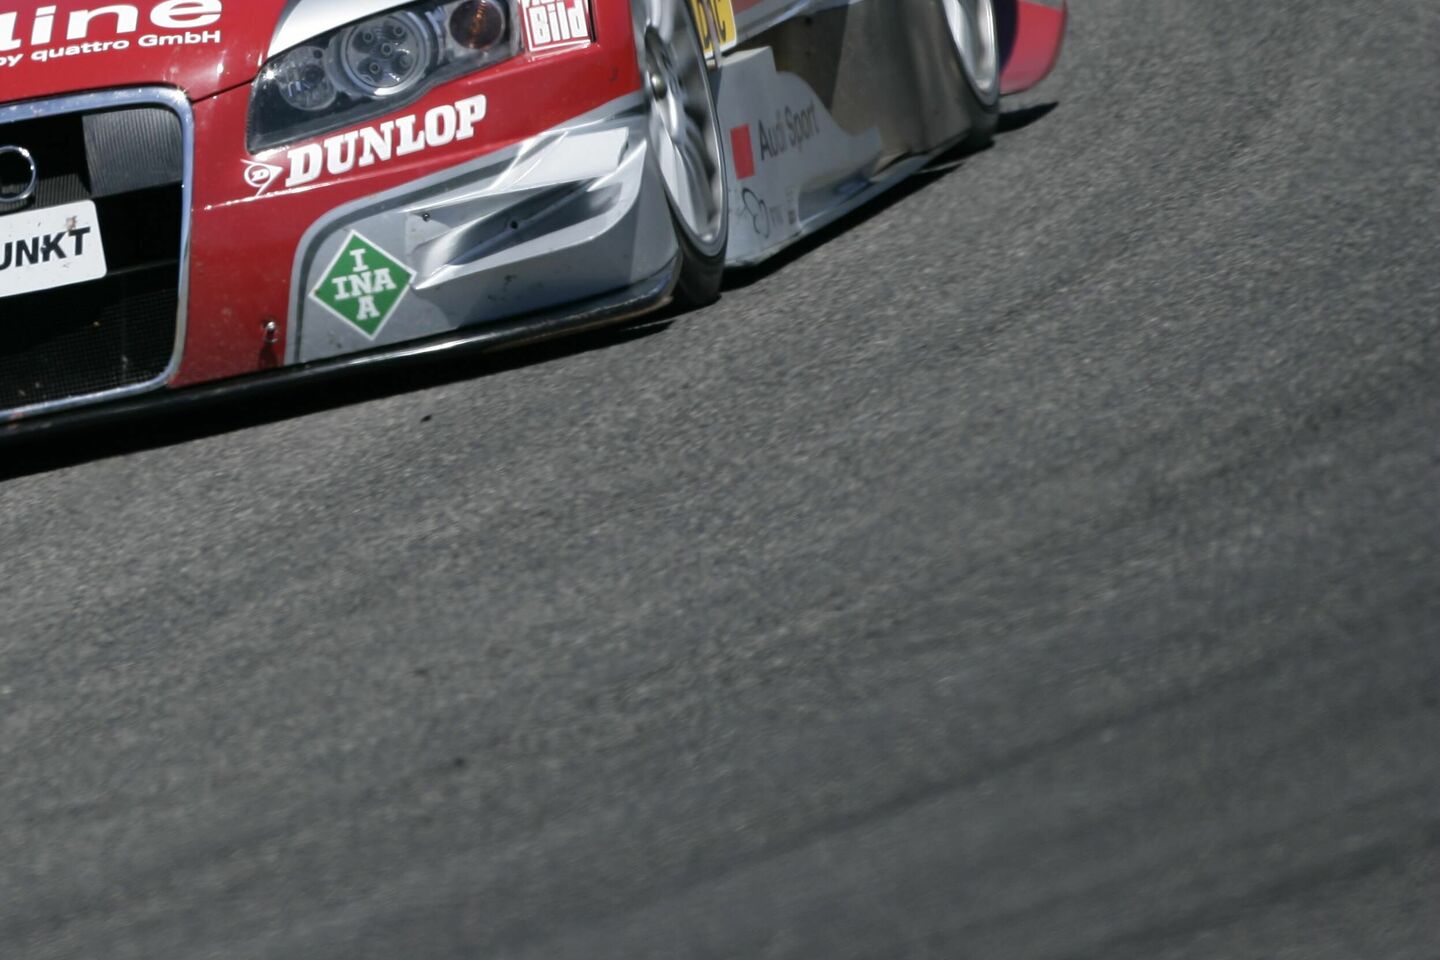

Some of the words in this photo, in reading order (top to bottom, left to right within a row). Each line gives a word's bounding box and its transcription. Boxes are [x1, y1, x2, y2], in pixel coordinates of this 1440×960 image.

[528, 0, 589, 45] Bild
[30, 39, 130, 62] quattro
[138, 30, 221, 48] GmbH
[284, 93, 488, 188] DUNLOP
[331, 268, 397, 301] INA
